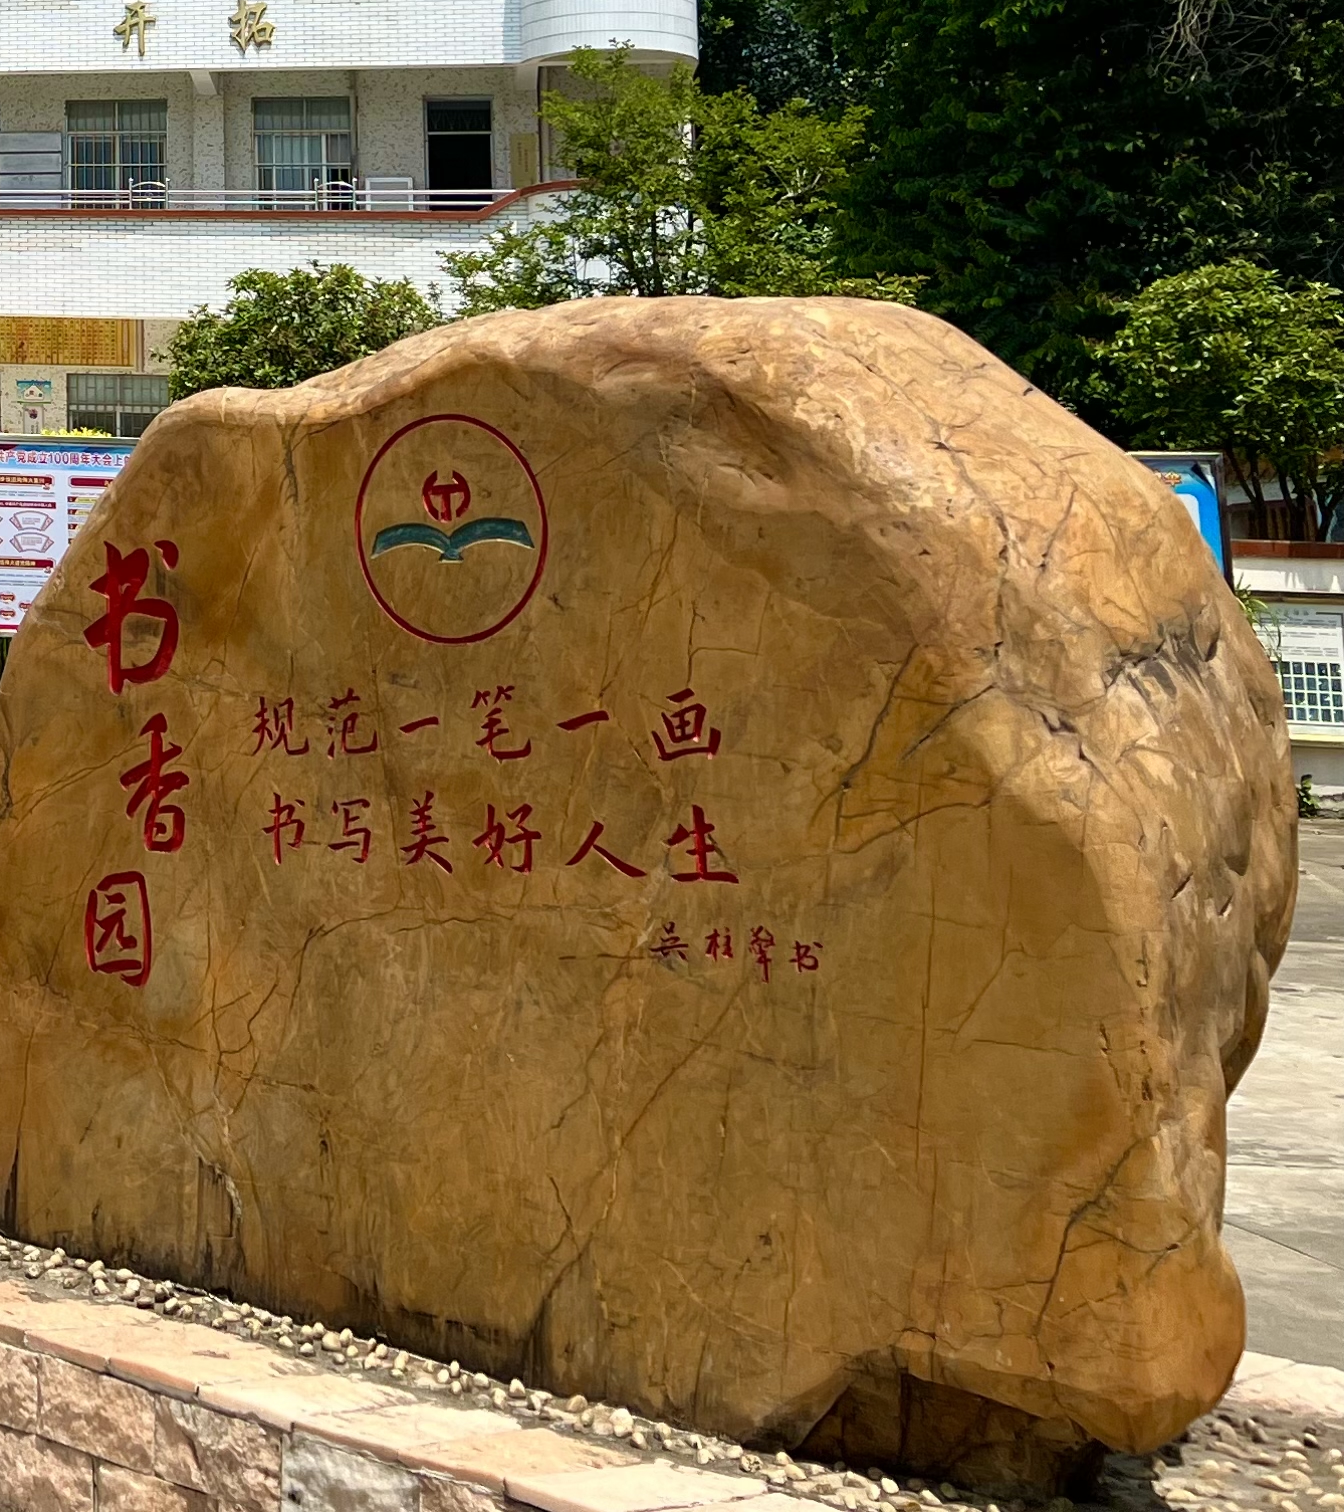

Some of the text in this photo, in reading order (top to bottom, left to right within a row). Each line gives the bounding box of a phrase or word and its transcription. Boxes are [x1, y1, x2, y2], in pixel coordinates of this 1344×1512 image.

[83, 538, 189, 987] 书香园
[252, 685, 721, 764] 规范一笔一画
[262, 790, 740, 885] 书写美好人生
